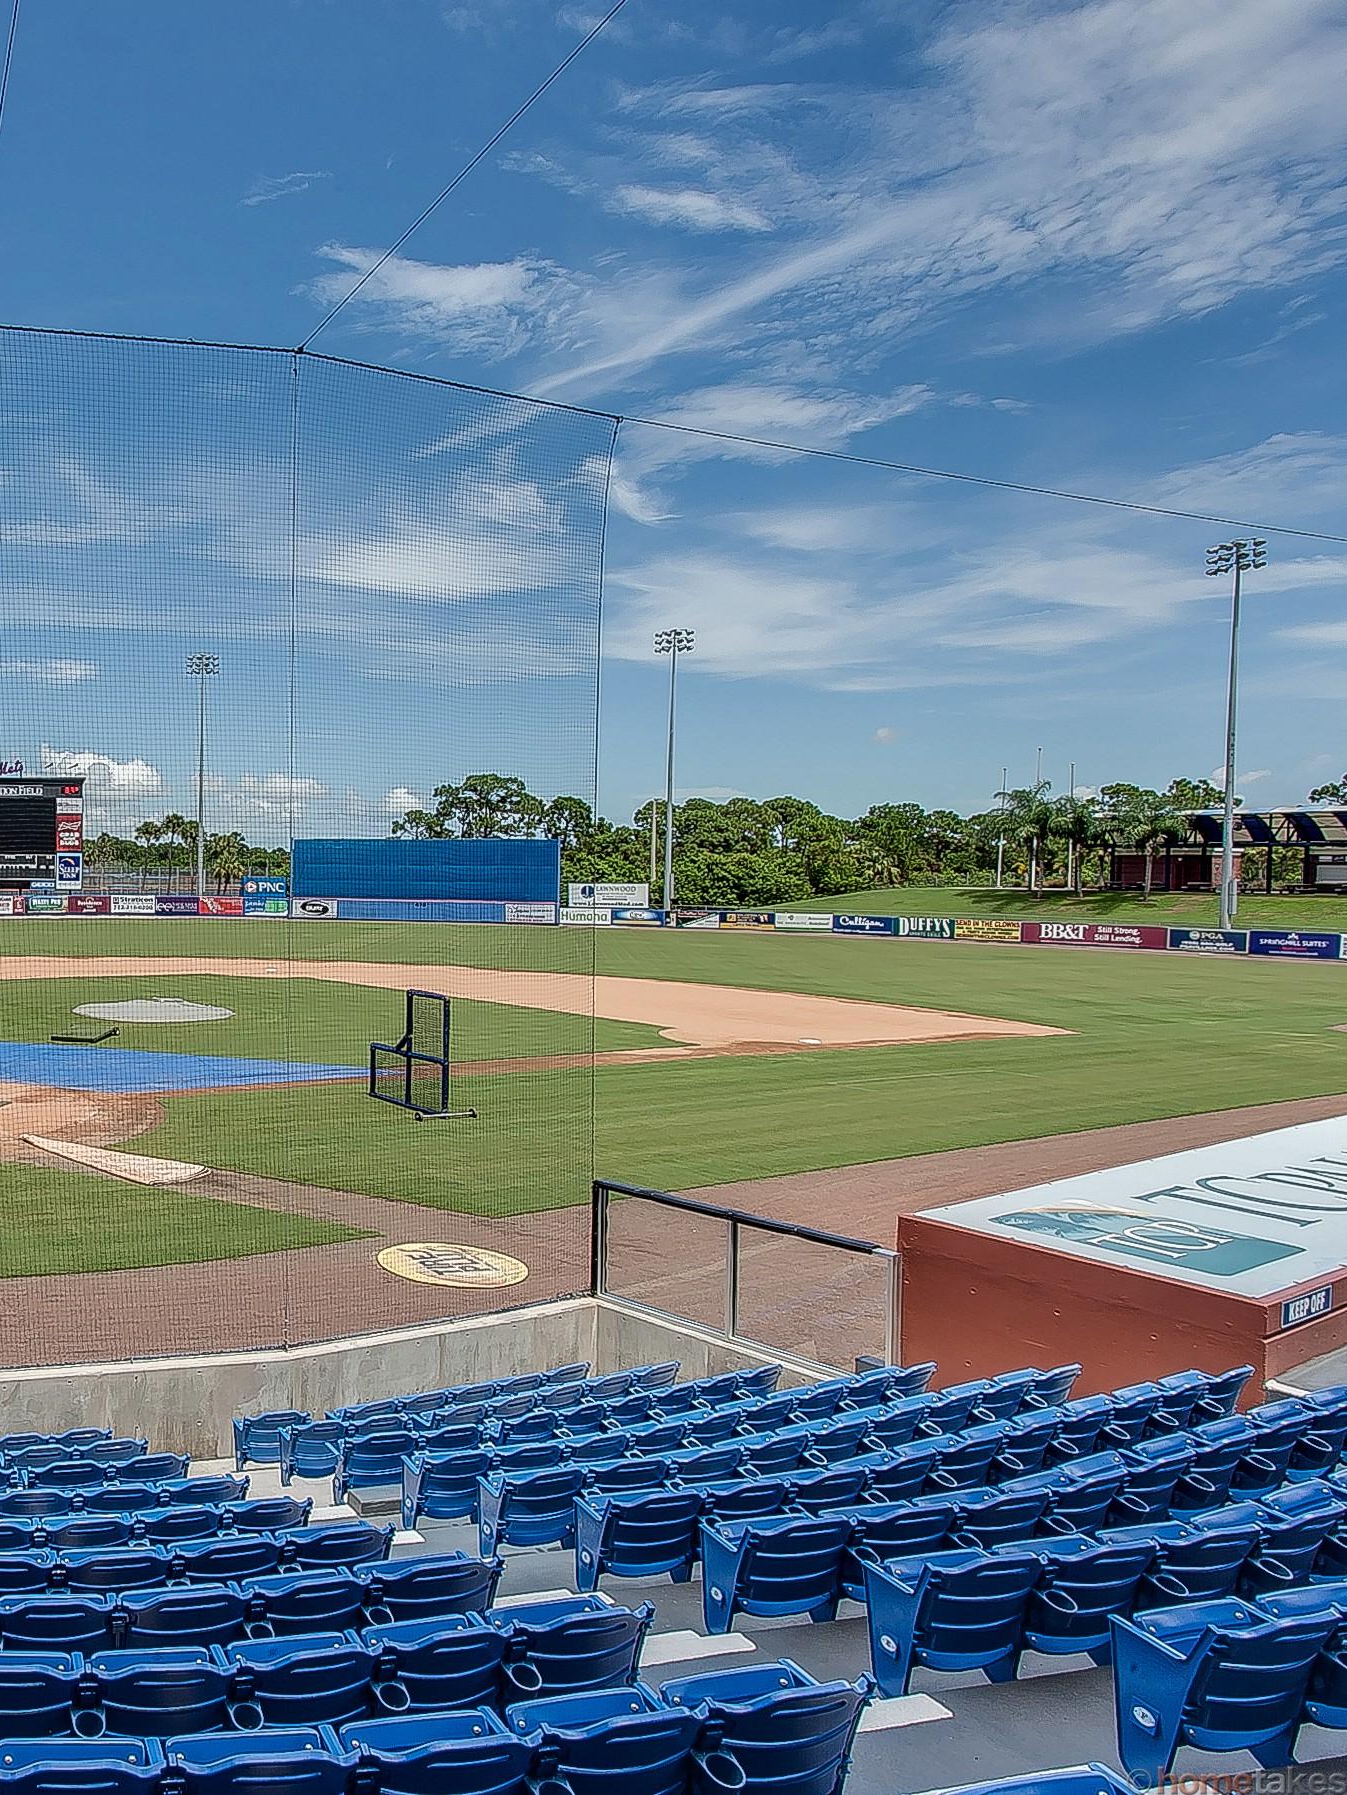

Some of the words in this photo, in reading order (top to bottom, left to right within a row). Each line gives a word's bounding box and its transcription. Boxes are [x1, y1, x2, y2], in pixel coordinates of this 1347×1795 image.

[19, 785, 43, 796] FIELD
[258, 881, 285, 893] PNC
[560, 911, 608, 922] Humana
[1039, 923, 1089, 940] BB&T
[1201, 932, 1224, 940] PGA
[1259, 939, 1301, 947] SPRINGHILL
[1288, 1299, 1310, 1323] KEEP
[1311, 1291, 1326, 1316] OFF
